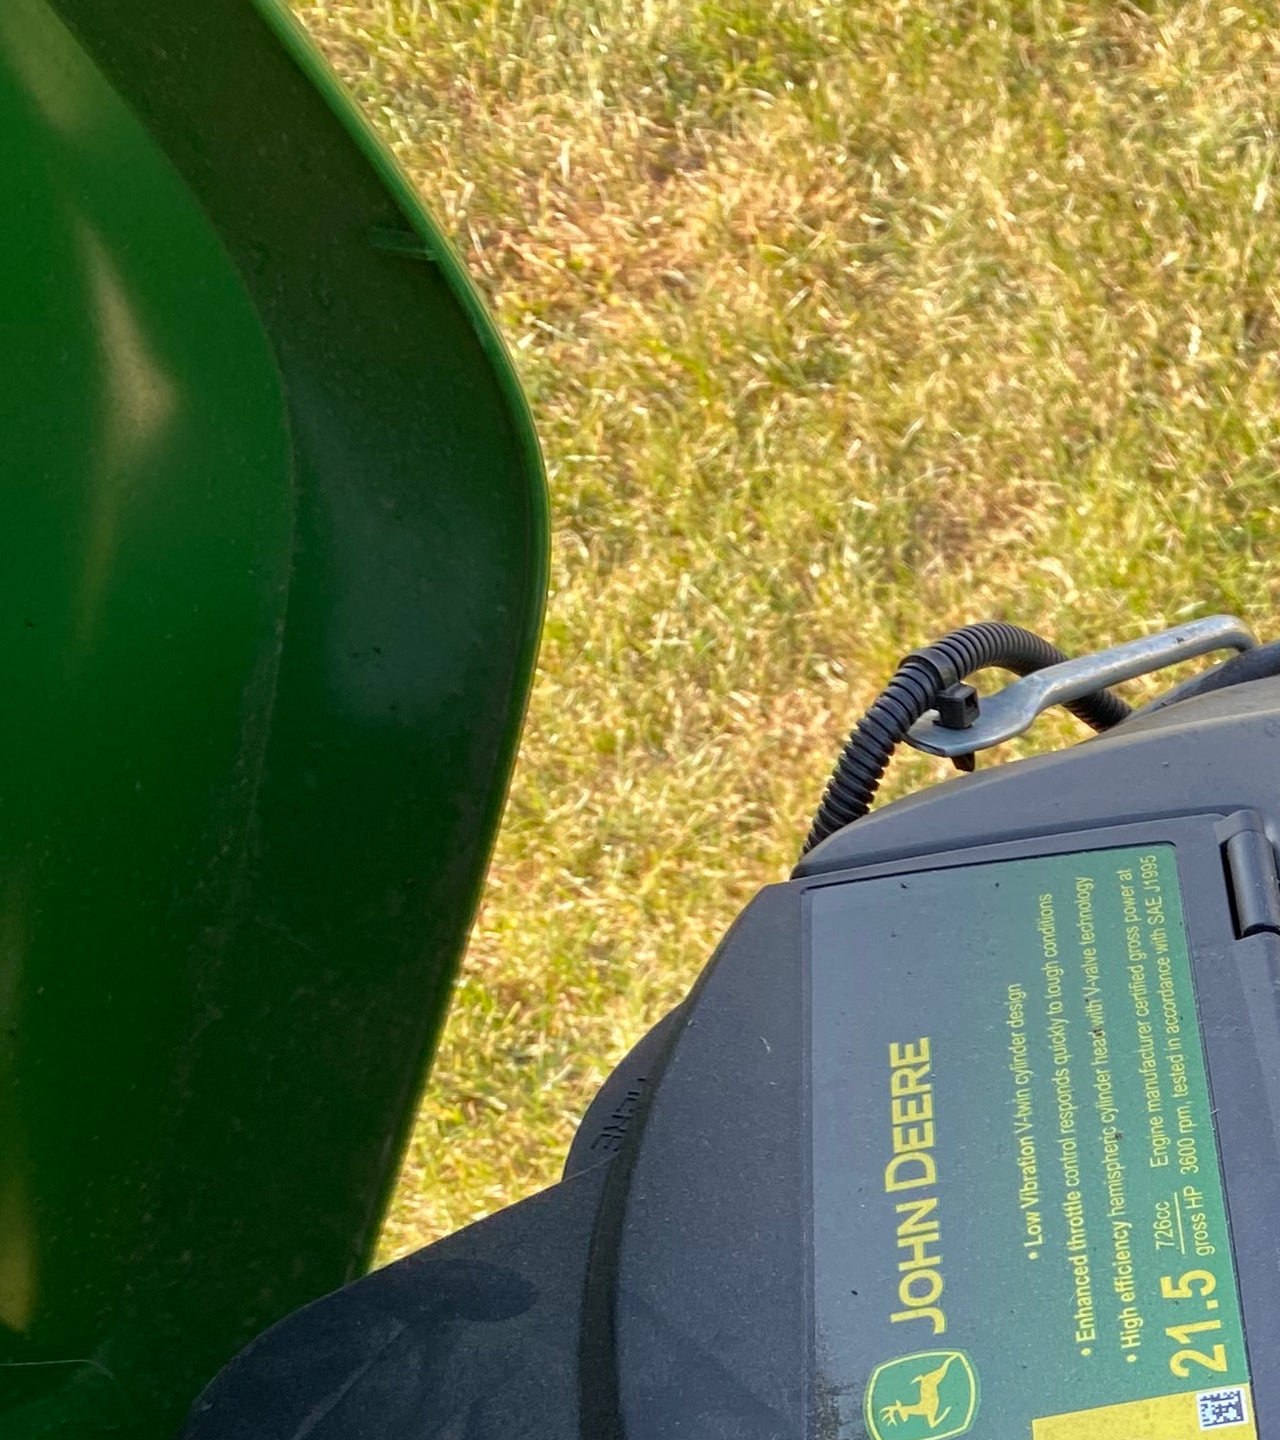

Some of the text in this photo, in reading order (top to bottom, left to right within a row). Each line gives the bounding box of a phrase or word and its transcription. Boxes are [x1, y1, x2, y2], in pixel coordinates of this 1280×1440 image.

[1004, 981, 1043, 1247] Low Vibration V-twin cylinder design
[1035, 891, 1096, 1343] Enhanced throttle control responds quickly to tough conditions
[1069, 873, 1147, 1349] High efficiency hemispheric cylinder head with V-valve technology
[1114, 866, 1173, 1167] Engine manufacturer certified gross power at
[1136, 852, 1200, 1175] 3600 rpm, tested in accordance with SAE J1995
[874, 1035, 947, 1338] JOHN DEERE
[1149, 1199, 1176, 1251] 726cc
[1157, 1265, 1229, 1379] 21.5
[1182, 1182, 1217, 1257] gross HP
